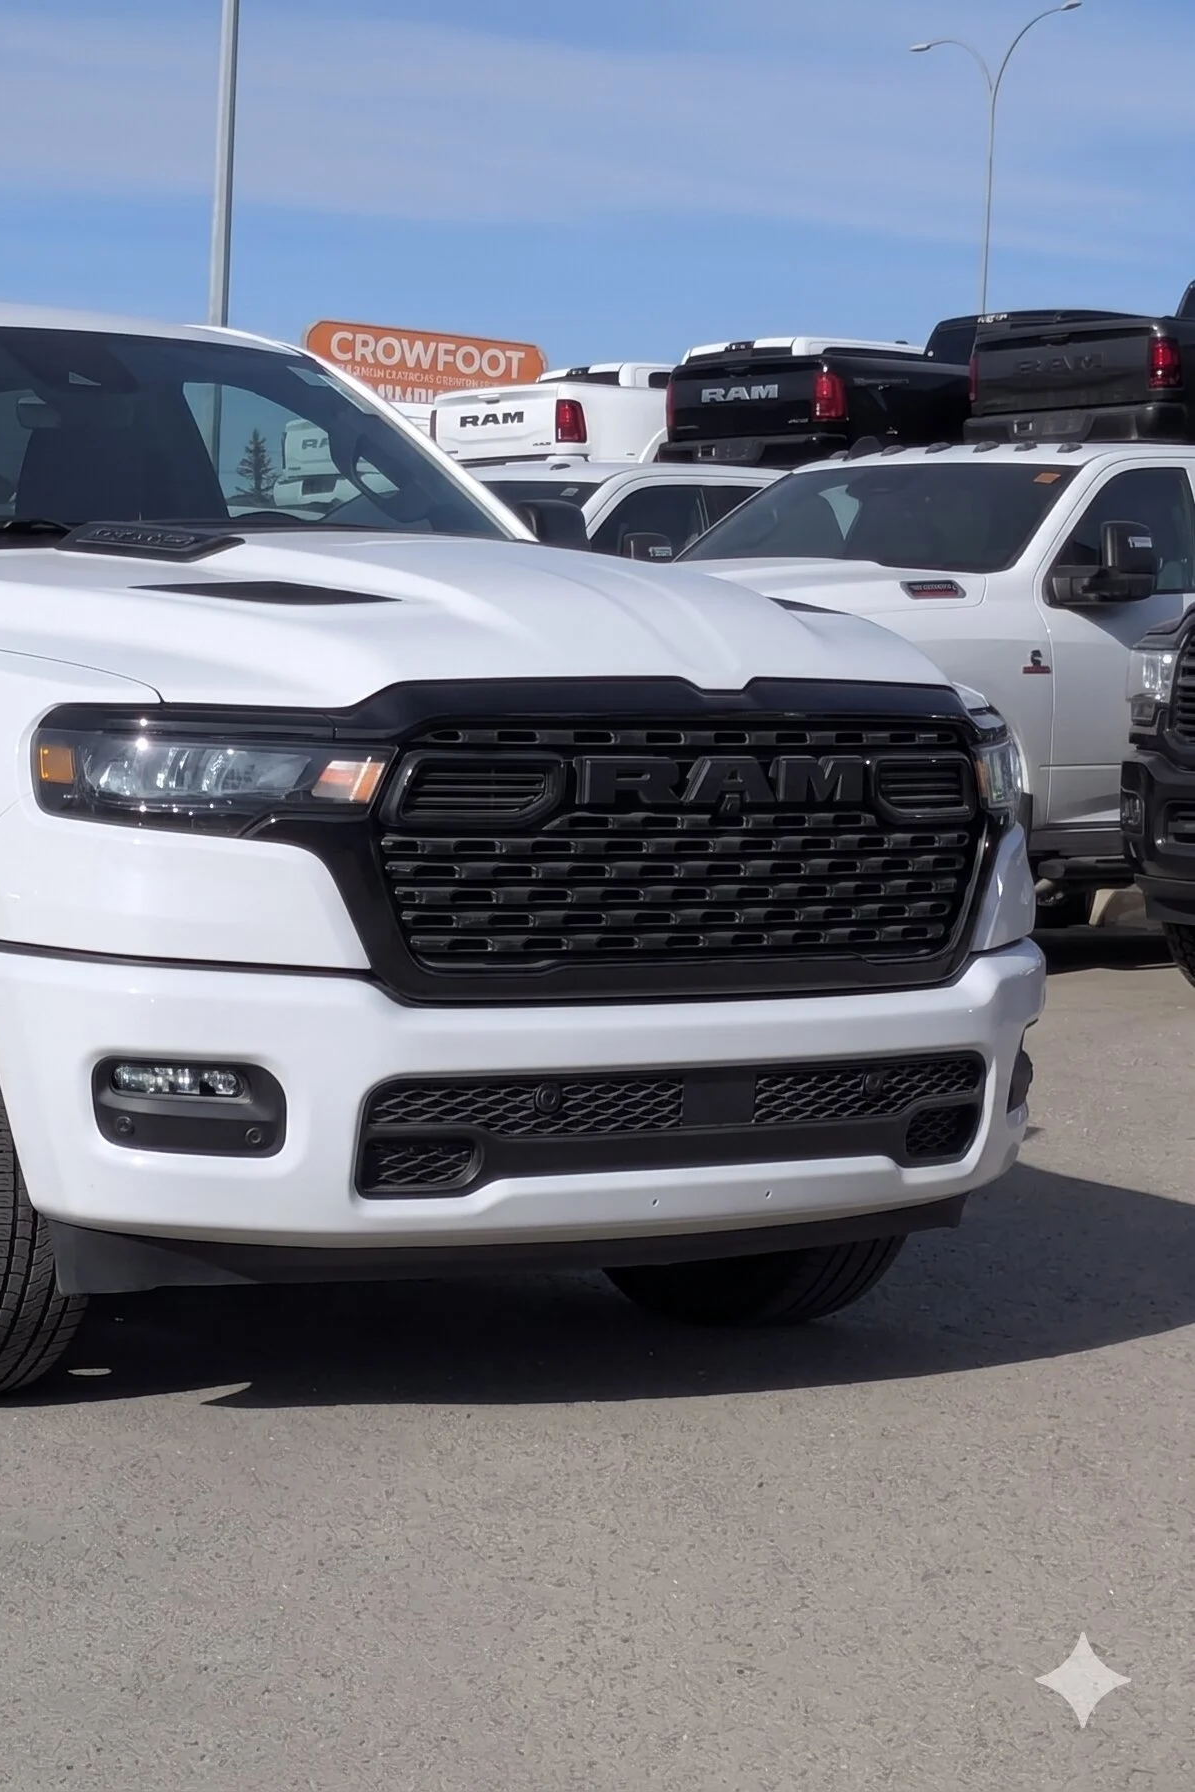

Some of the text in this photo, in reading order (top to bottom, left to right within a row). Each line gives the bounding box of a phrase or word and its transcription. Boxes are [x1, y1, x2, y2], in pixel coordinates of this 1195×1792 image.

[330, 331, 525, 380] CROWFOOT
[701, 384, 779, 403] RAM
[459, 411, 525, 428] RAM
[573, 756, 865, 805] RAM
